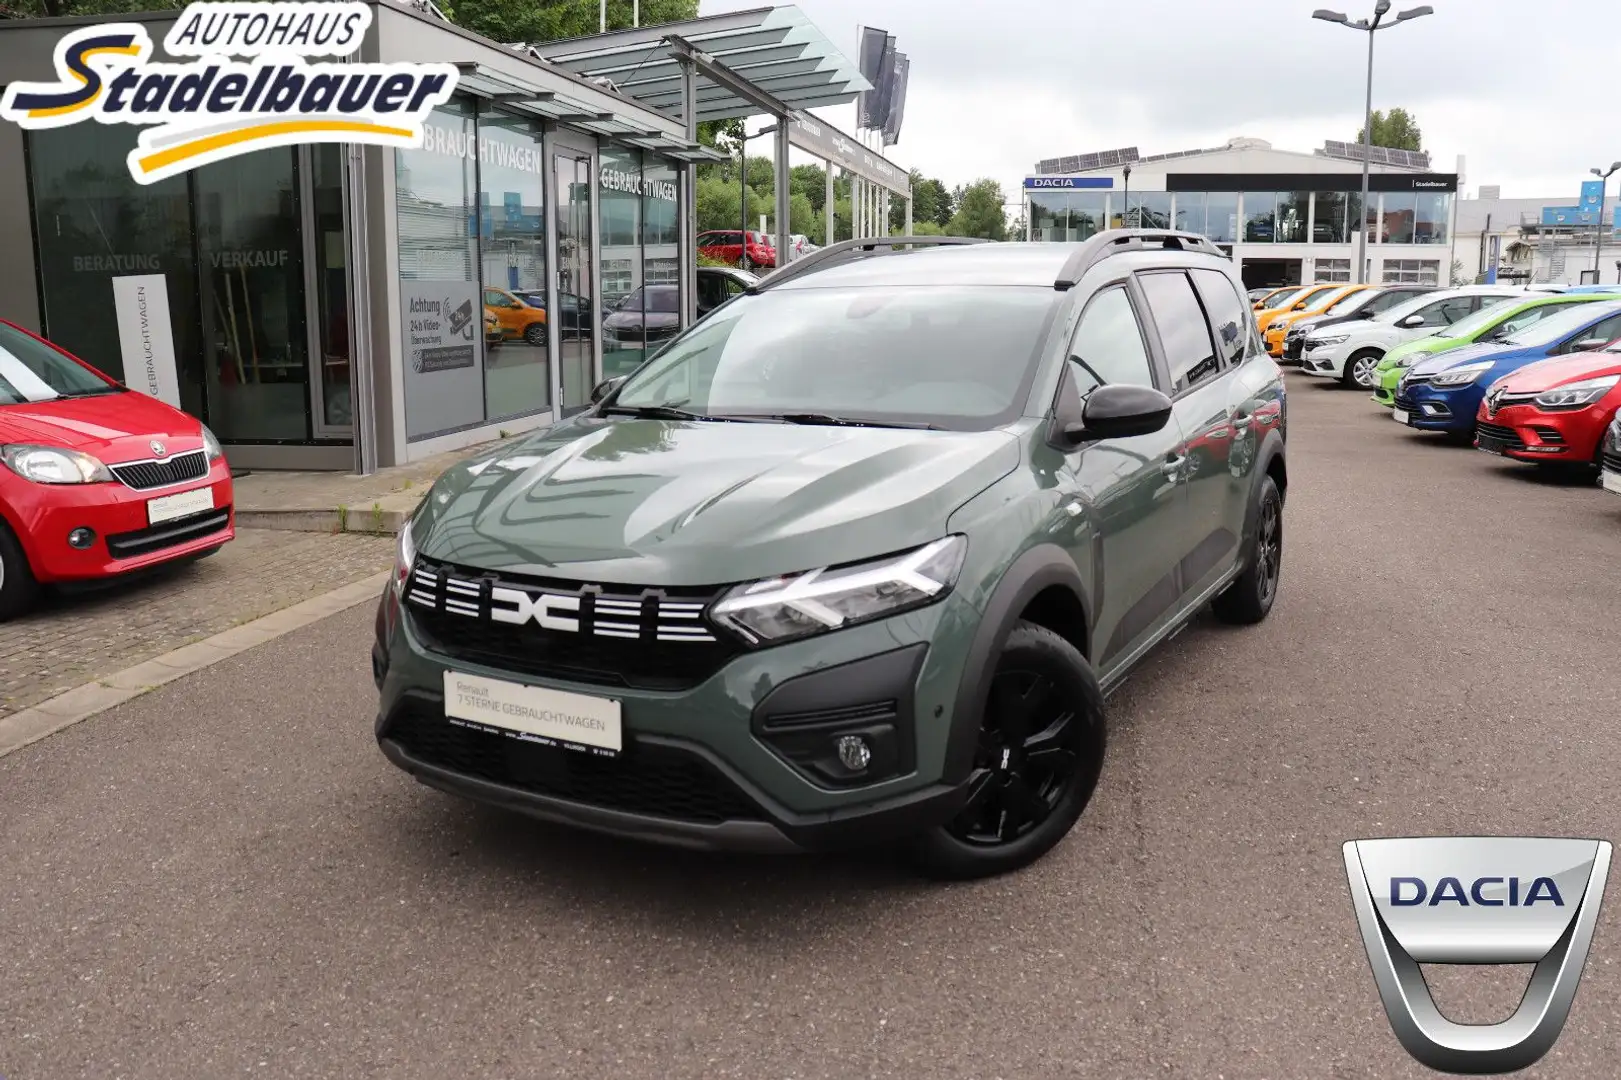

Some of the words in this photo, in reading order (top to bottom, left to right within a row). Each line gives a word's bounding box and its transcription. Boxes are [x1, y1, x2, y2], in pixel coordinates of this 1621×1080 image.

[421, 123, 541, 174] BRAUCHTWAGEN
[601, 167, 678, 202] GEBRAUCHTWAGEN
[1034, 178, 1075, 188] DACIA
[73, 253, 161, 272] BERATUNG
[210, 249, 289, 268] VERKAUF
[409, 297, 441, 316] Achtung
[137, 286, 159, 396] GEBRAUCHTWAGEN
[456, 680, 490, 697] Renault
[458, 694, 464, 705] 7
[464, 694, 501, 713] STERNE
[502, 702, 606, 732] GEBRAUCHTWAGEN
